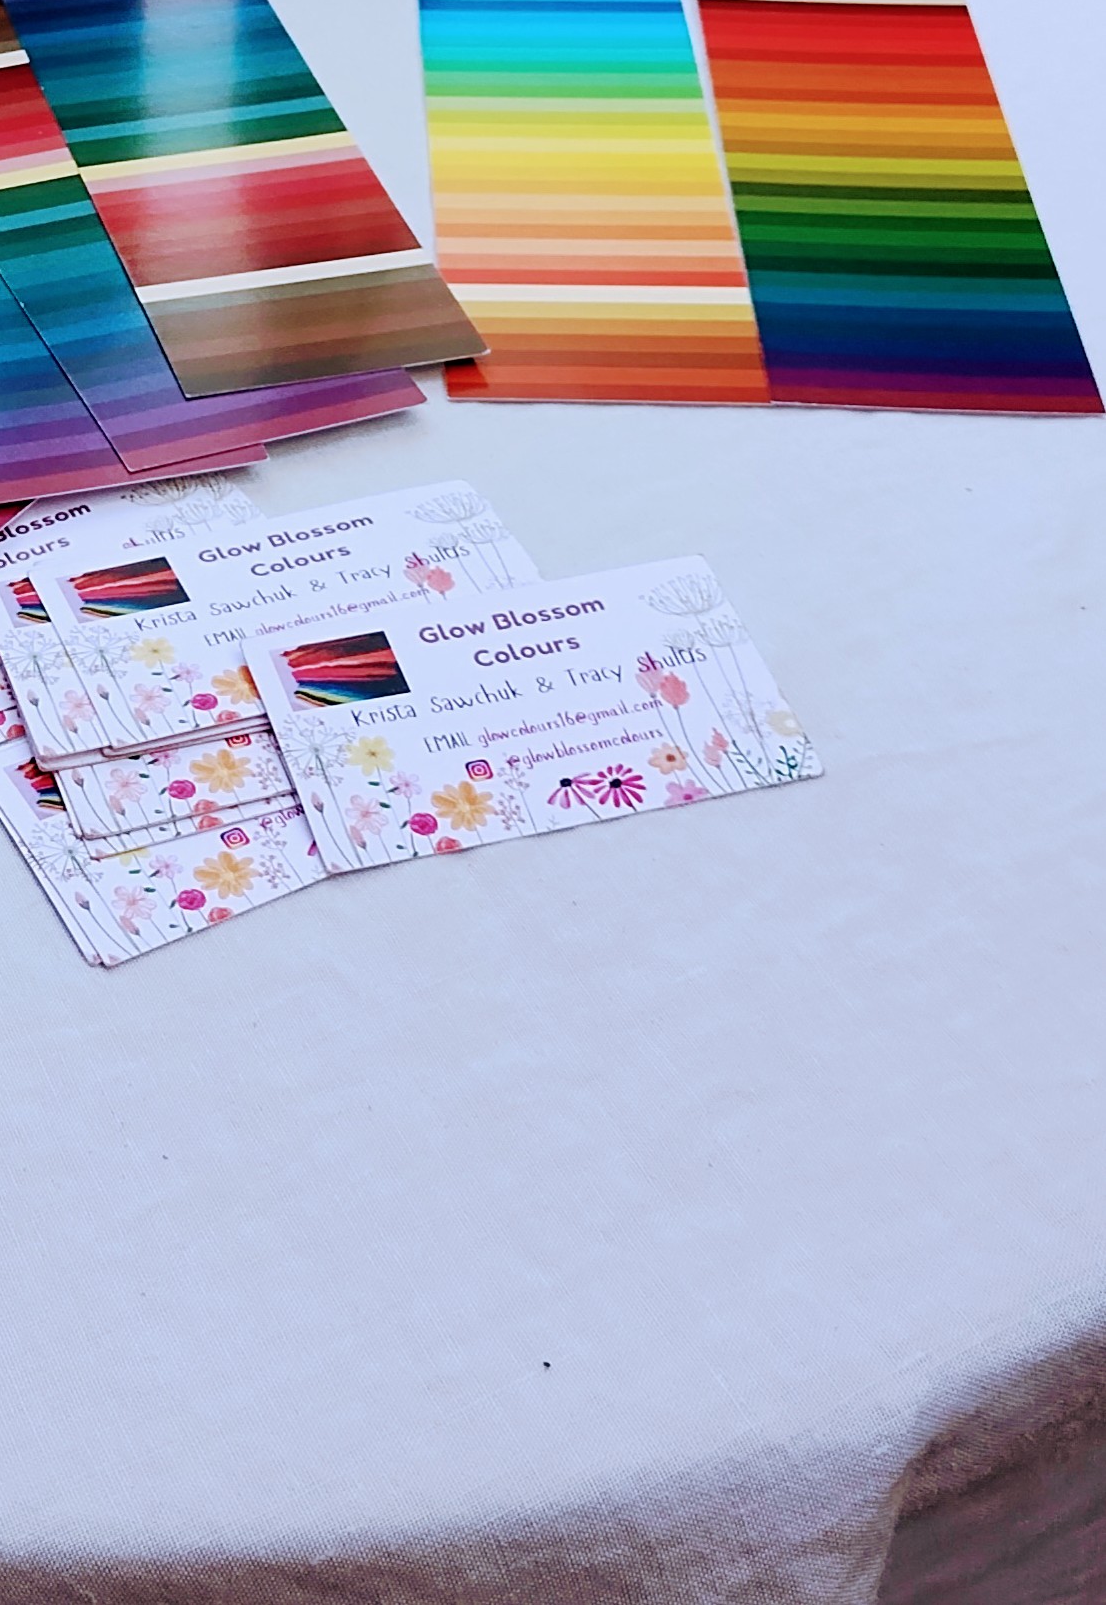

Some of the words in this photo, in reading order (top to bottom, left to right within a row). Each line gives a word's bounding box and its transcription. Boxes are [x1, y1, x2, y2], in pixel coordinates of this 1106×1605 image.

[197, 538, 263, 564] Glow
[267, 514, 375, 549] Blossom
[249, 544, 352, 578] Colours
[135, 609, 198, 633] Krista
[209, 584, 299, 616] Sawchuk
[310, 578, 327, 593] &
[337, 563, 393, 586] Tracy
[417, 619, 486, 645] Glow
[492, 596, 606, 631] Blossom
[203, 626, 248, 647] EMAIL
[472, 635, 581, 669] Colours
[350, 702, 418, 729] Krista
[430, 680, 524, 715] Sawchuk
[535, 676, 556, 694] &
[564, 662, 624, 688] Tracy
[423, 731, 473, 754] EMAIL
[477, 698, 664, 749] glowcolours16@gmail.com
[506, 727, 664, 770] @glowblossomcolours
